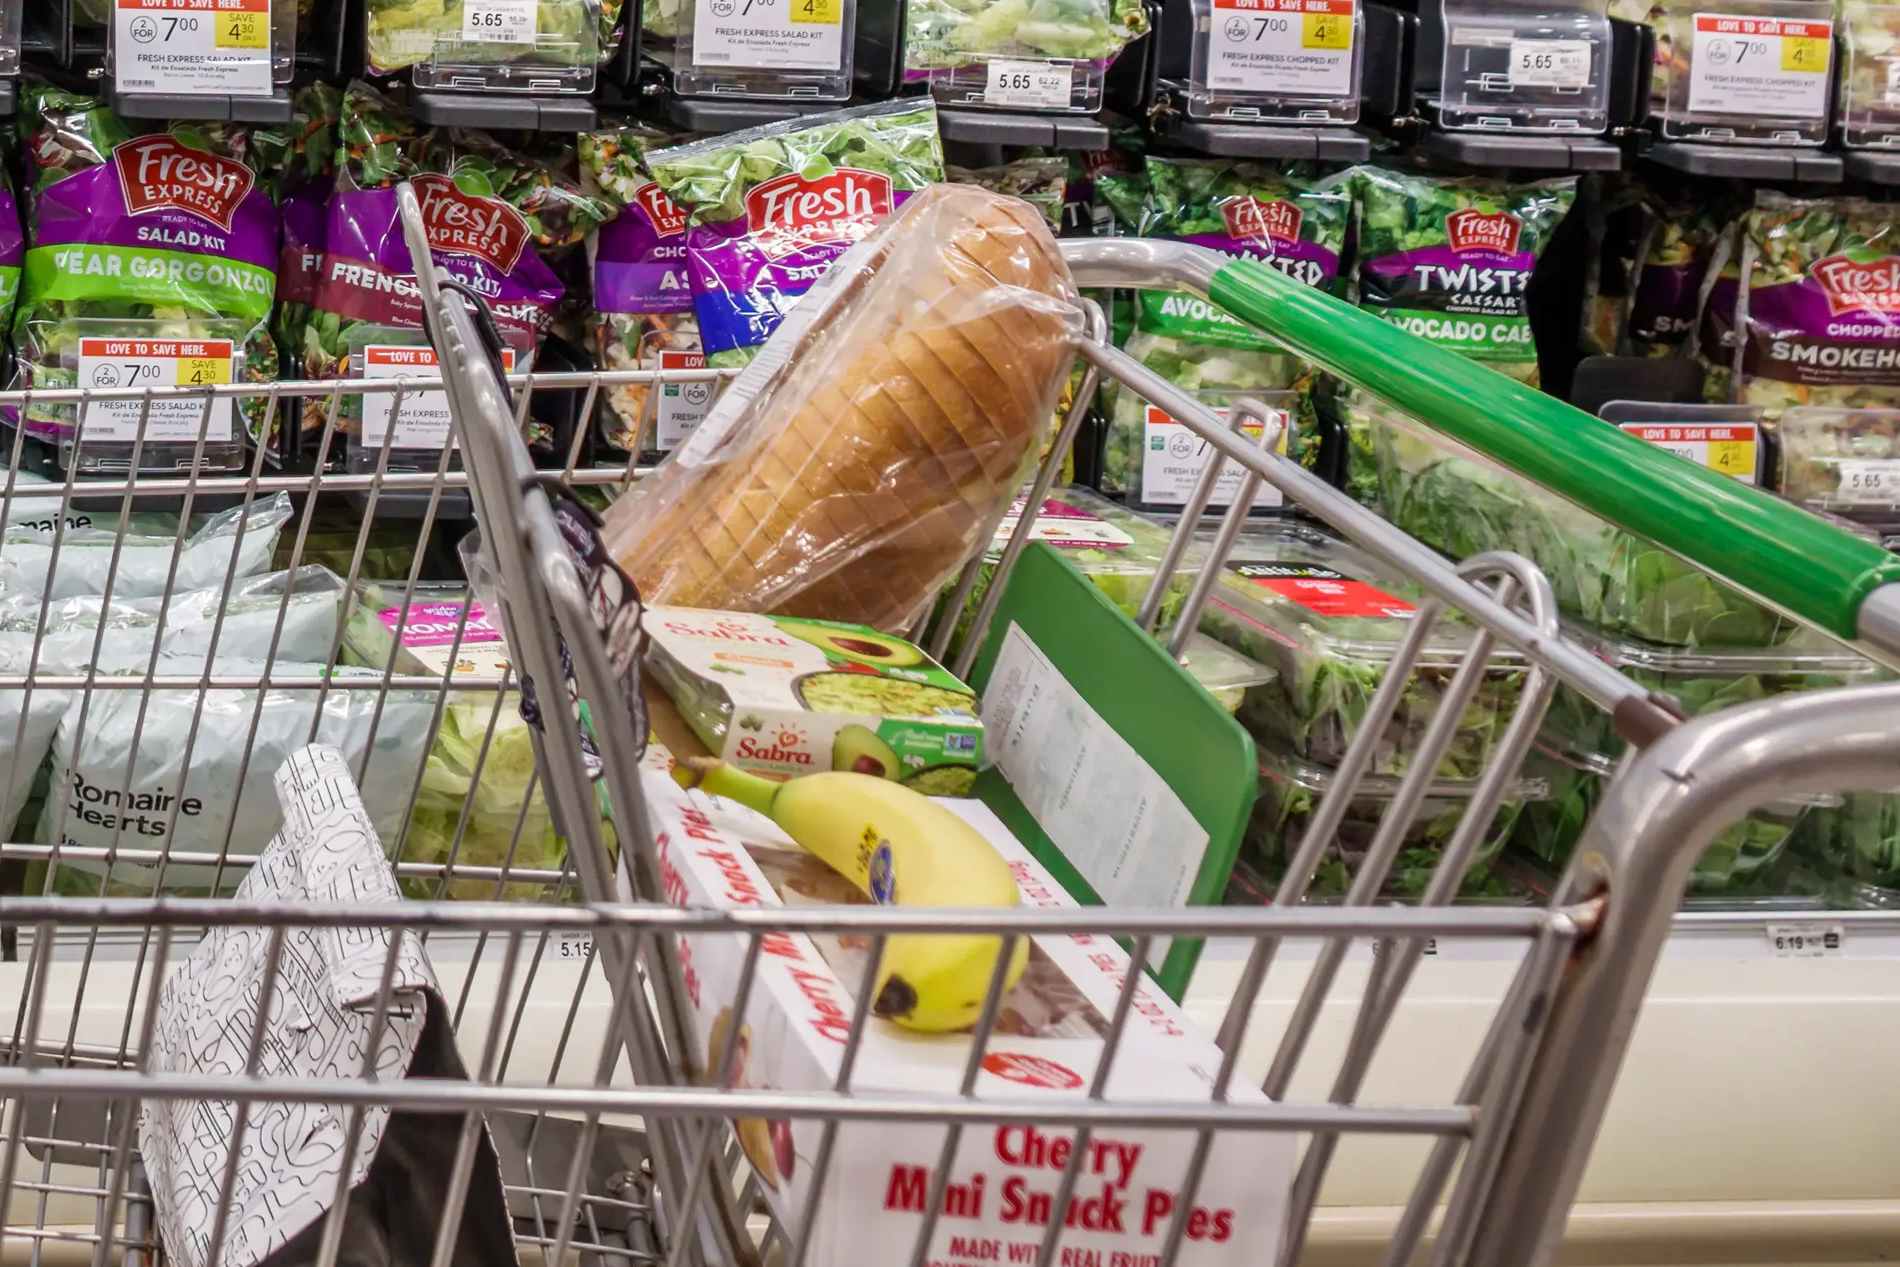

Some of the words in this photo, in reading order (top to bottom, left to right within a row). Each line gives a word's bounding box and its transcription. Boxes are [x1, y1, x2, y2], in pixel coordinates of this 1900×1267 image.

[220, 0, 245, 9] HERE.
[472, 11, 503, 27] 5.65
[1523, 54, 1552, 69] 5.65
[999, 74, 1030, 90] 5.65
[137, 144, 236, 197] Fresh
[144, 184, 221, 216] EXPRESS
[736, 737, 812, 765] Sabra
[995, 1124, 1142, 1186] Chery
[949, 1237, 1001, 1262] MADE
